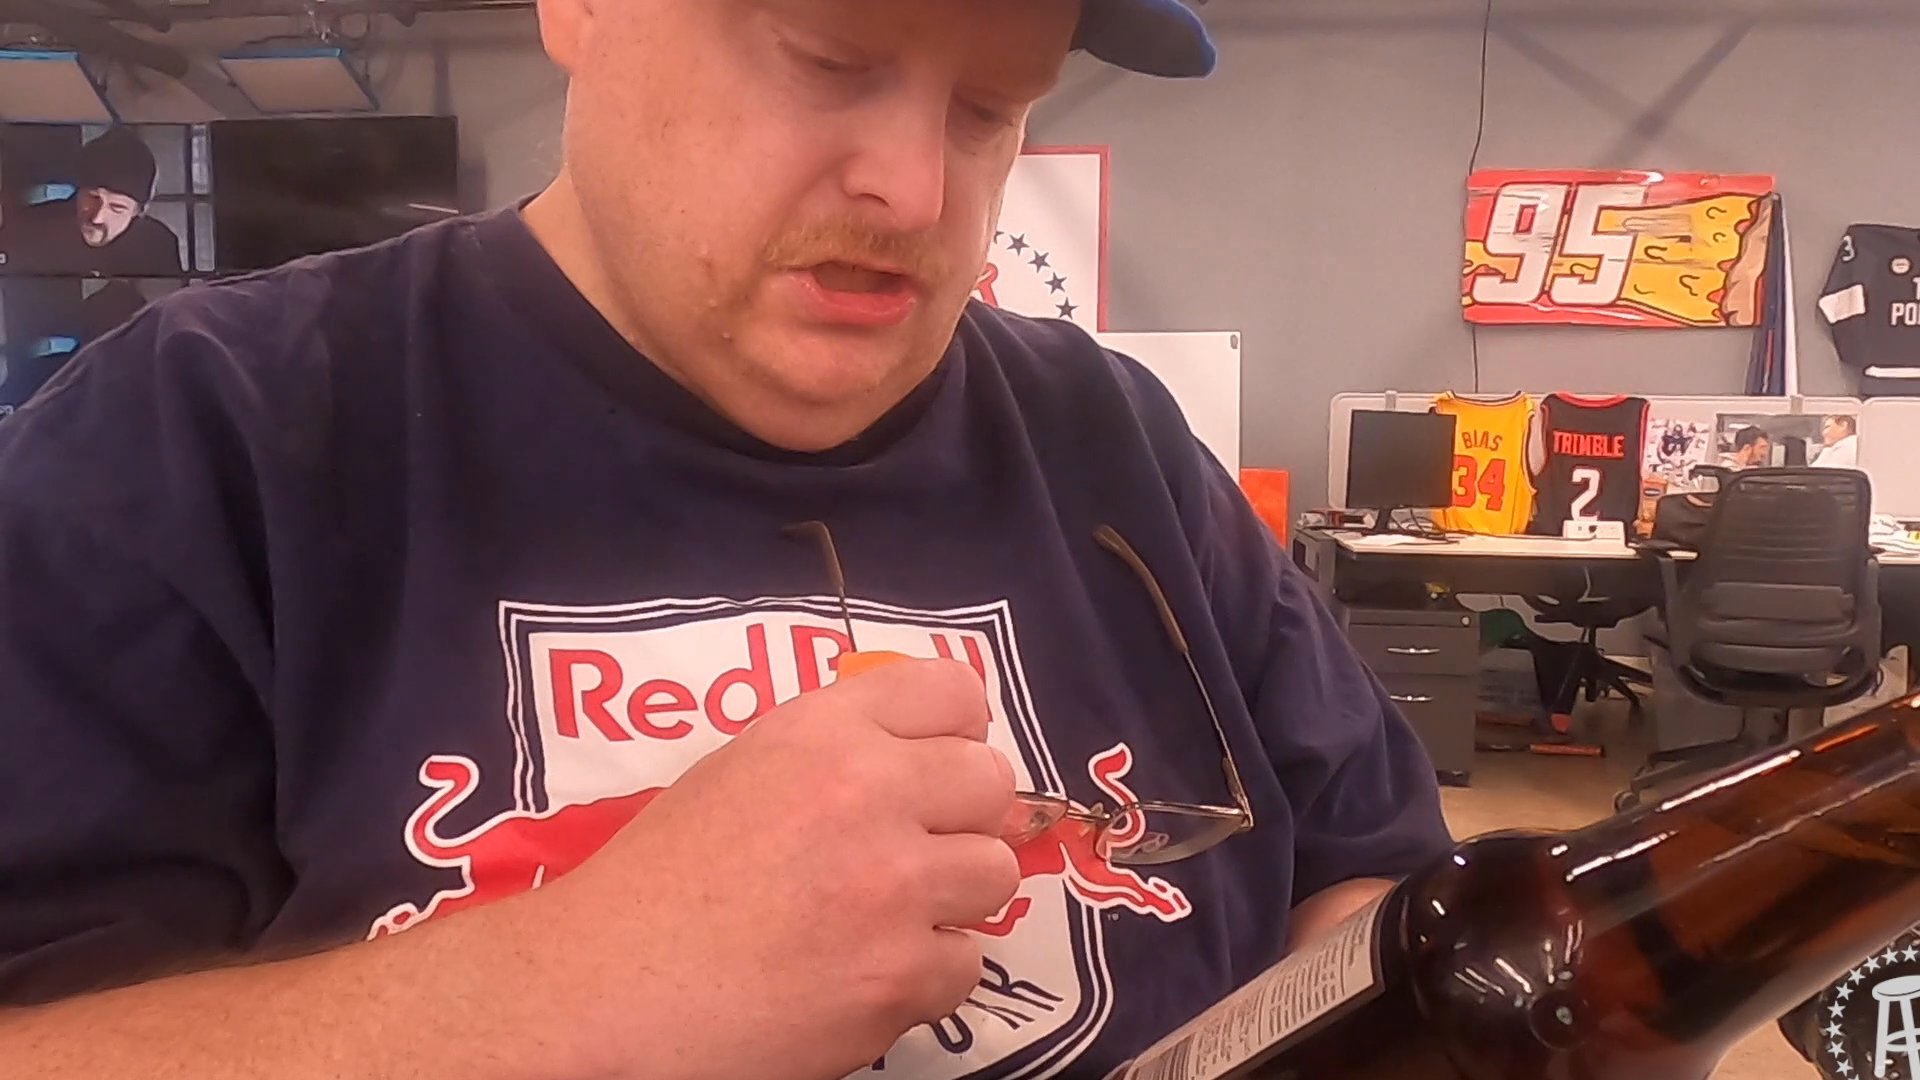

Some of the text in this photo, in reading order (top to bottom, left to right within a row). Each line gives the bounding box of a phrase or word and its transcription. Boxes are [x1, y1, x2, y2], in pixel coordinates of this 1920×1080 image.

[1469, 182, 1649, 306] 95
[1890, 302, 1920, 326] PO
[1461, 429, 1503, 451] BIAS
[1552, 431, 1626, 458] TRIMBLE
[1453, 454, 1507, 511] 34
[1571, 467, 1601, 521] 2
[548, 622, 778, 742] Red
